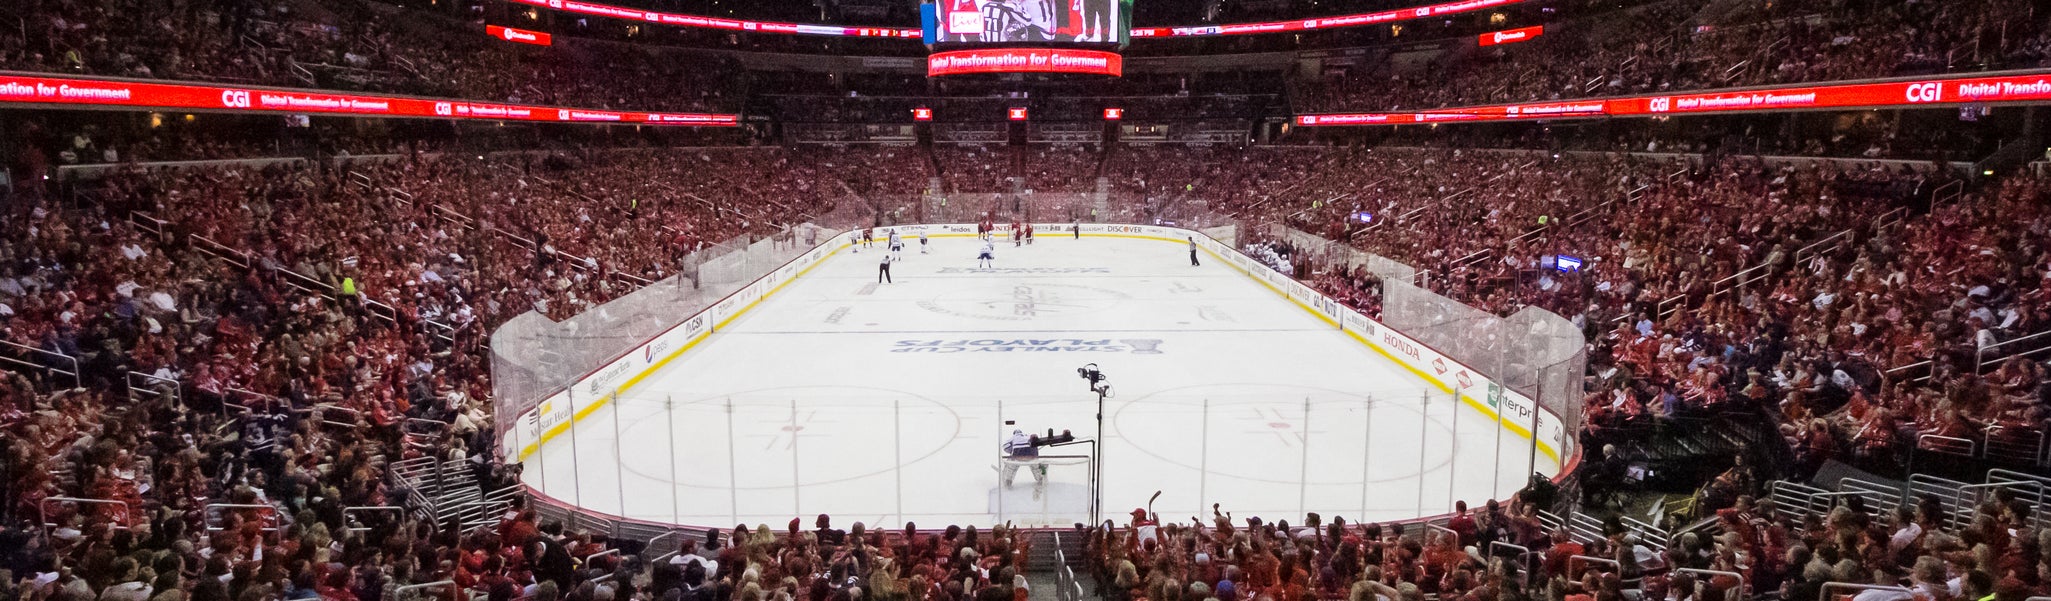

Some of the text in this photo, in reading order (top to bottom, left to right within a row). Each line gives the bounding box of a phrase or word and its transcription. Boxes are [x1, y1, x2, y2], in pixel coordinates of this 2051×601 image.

[950, 54, 1026, 66] Transformation
[1030, 53, 1047, 65] for
[1051, 54, 1107, 68] Government
[37, 83, 56, 97] for
[60, 84, 130, 100] Government
[222, 90, 250, 107] CGI
[1905, 82, 1942, 102] CGI
[1959, 82, 2000, 100] Digital
[436, 103, 452, 115] CGI
[1650, 92, 1815, 112] CGI Digital Transformation for Government
[893, 339, 1113, 347] PLAYOFFS
[1383, 332, 1420, 361] HONDA
